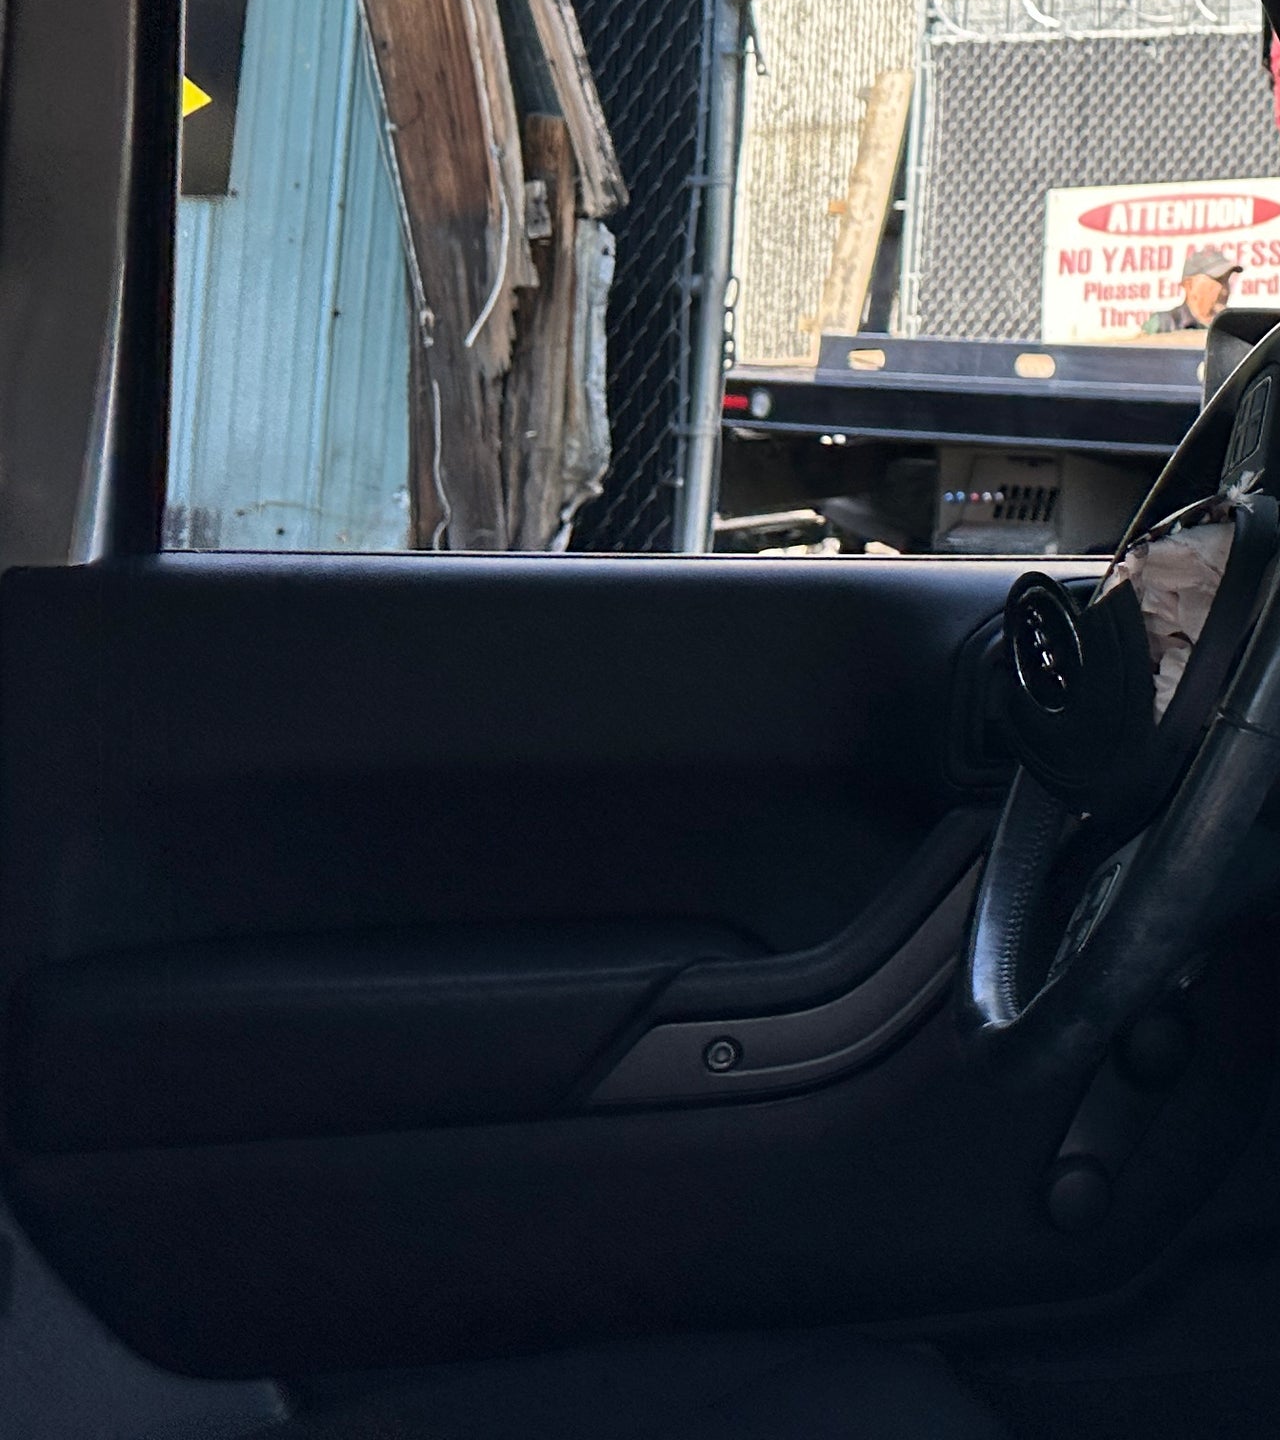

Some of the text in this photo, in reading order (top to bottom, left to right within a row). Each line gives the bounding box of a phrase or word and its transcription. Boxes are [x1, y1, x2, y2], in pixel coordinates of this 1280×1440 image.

[1107, 197, 1255, 233] ATTENTION
[1058, 247, 1093, 276] NO
[1102, 243, 1174, 274] YARD
[1083, 279, 1151, 302] Please
